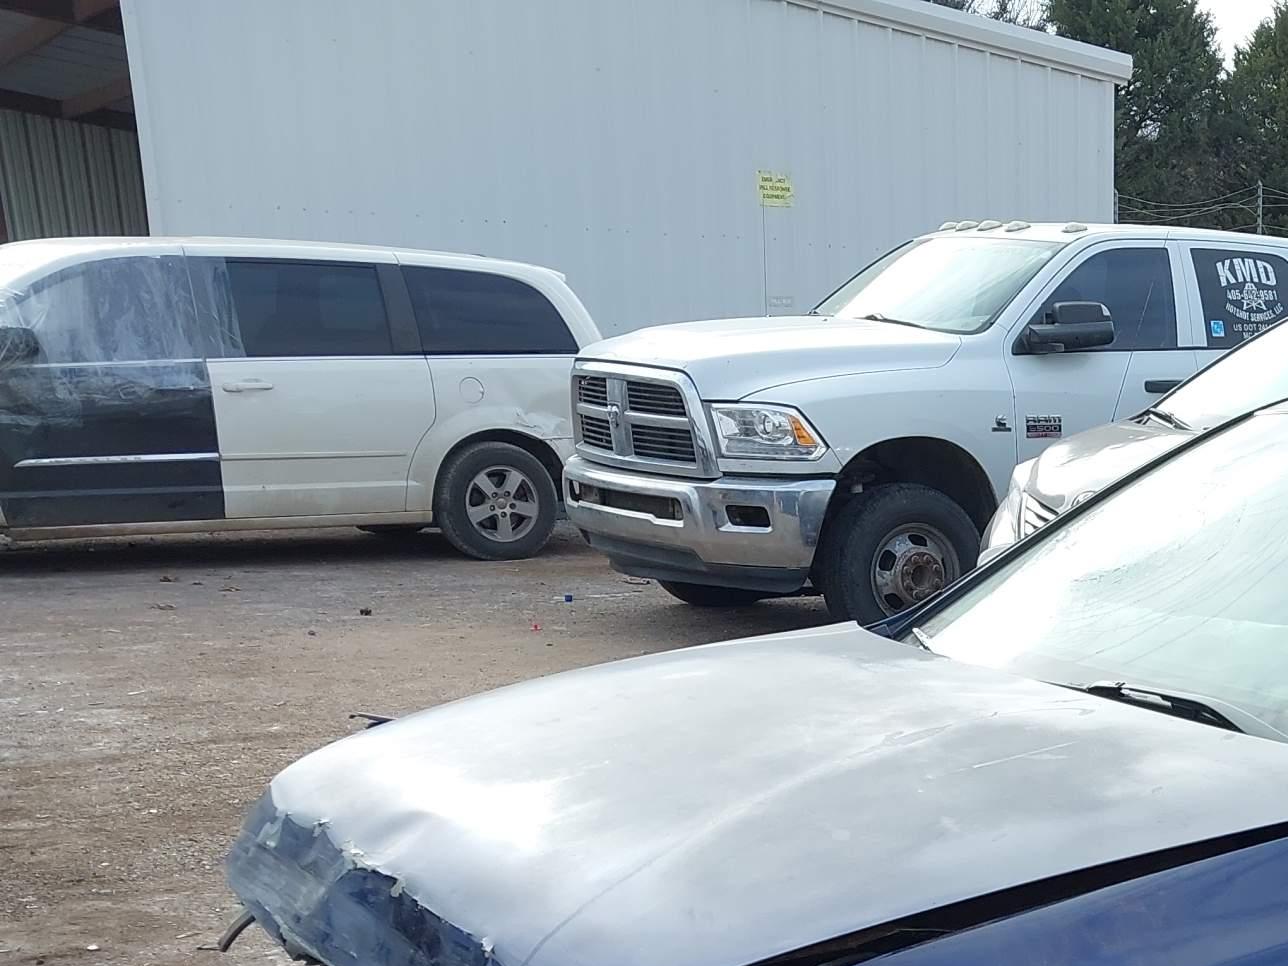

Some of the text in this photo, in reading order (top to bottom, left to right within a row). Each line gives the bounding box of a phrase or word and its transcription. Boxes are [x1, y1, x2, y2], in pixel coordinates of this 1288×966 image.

[1216, 258, 1277, 287] KMD
[1274, 302, 1284, 315] LLC
[1233, 323, 1243, 332] US
[1244, 323, 1257, 332] DOT
